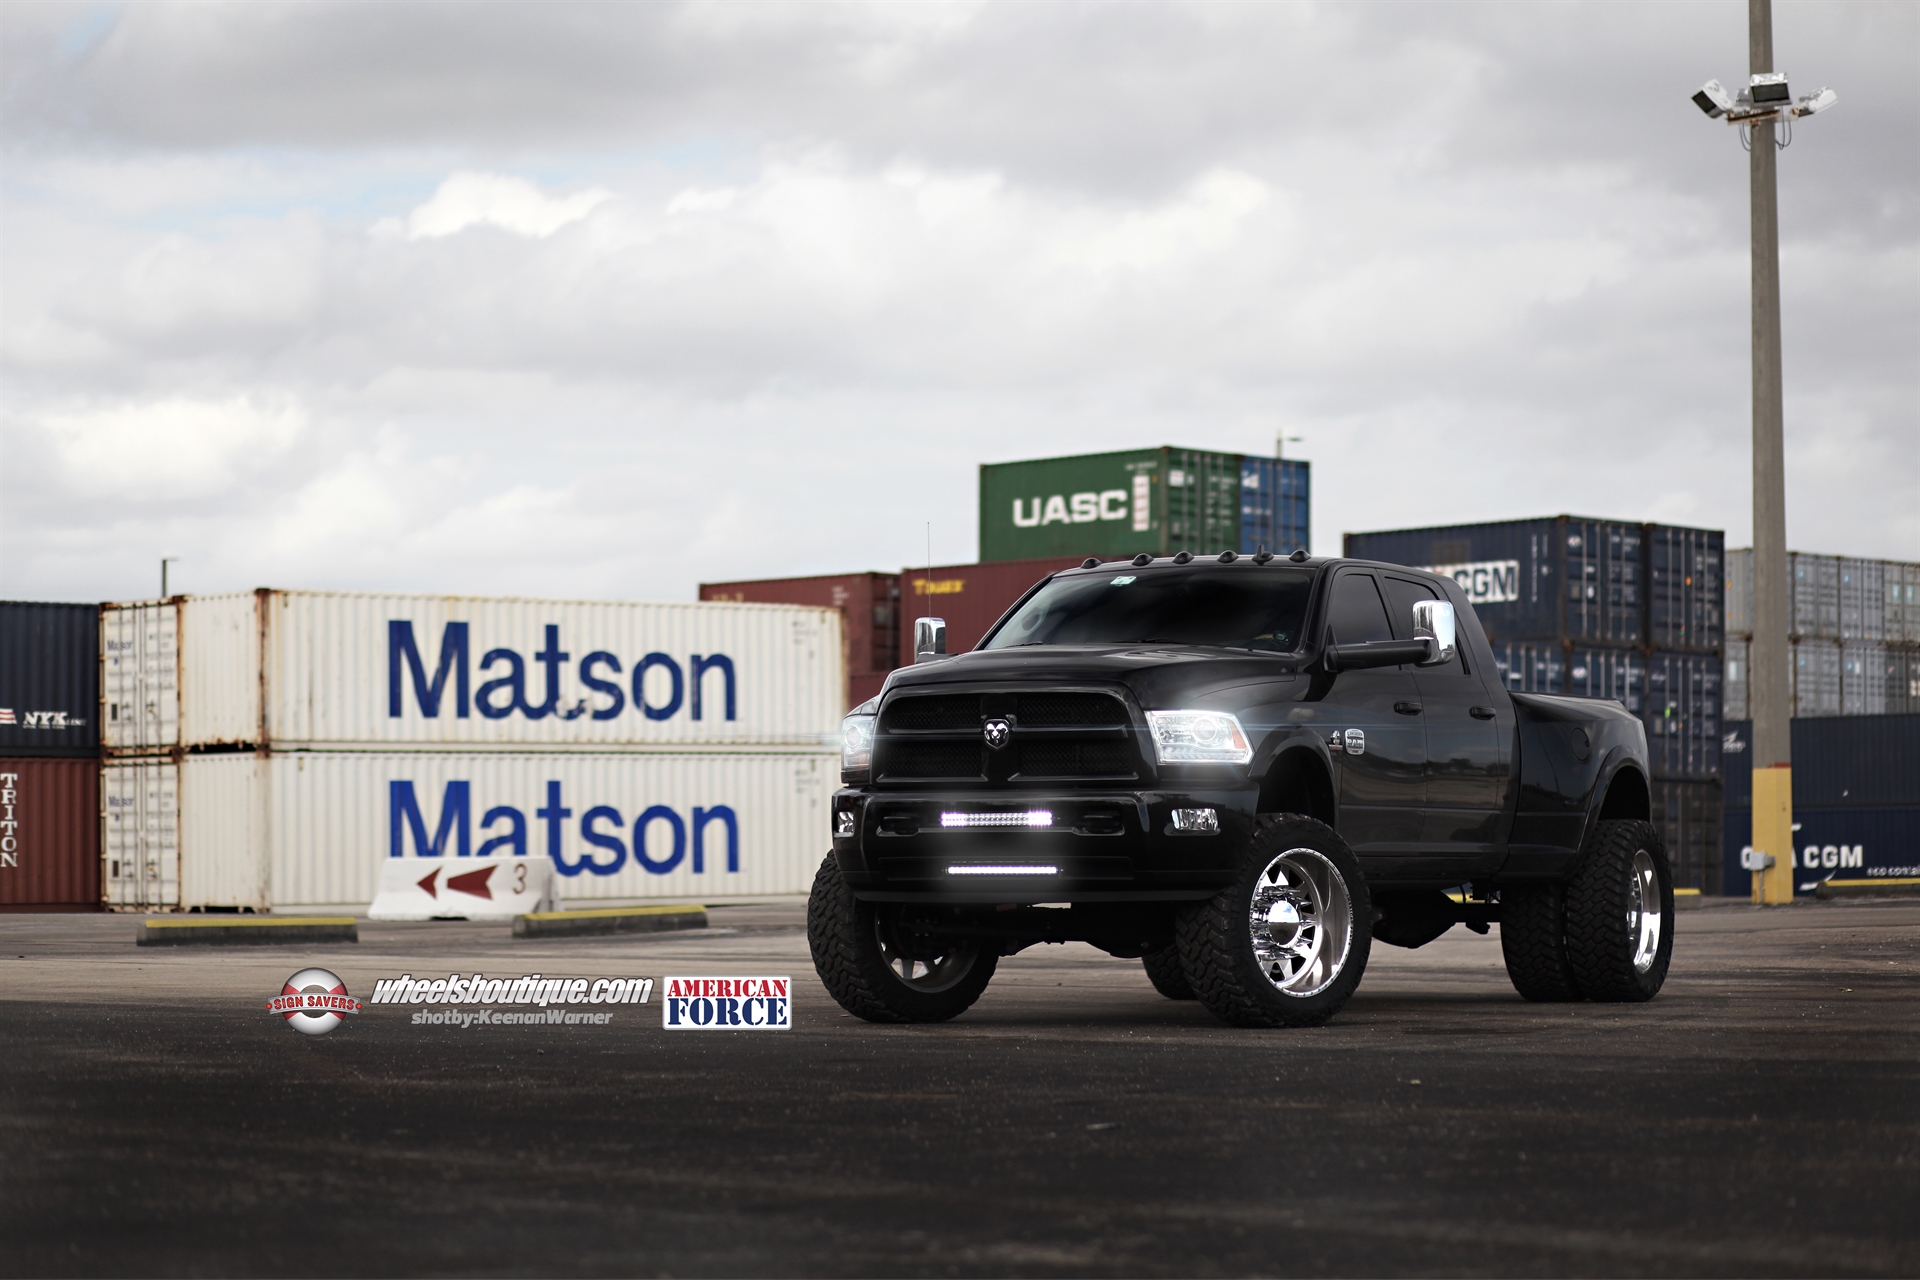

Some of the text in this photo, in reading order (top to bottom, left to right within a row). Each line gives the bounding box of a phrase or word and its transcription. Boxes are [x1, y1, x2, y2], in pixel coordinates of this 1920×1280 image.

[1013, 489, 1128, 528] UASC
[1454, 566, 1515, 597] CGM
[388, 620, 736, 721] Matson
[23, 711, 68, 726] NYK
[0, 773, 18, 867] TRITON
[389, 780, 739, 877] Matson
[1803, 844, 1863, 868] CGM
[513, 863, 528, 895] 3
